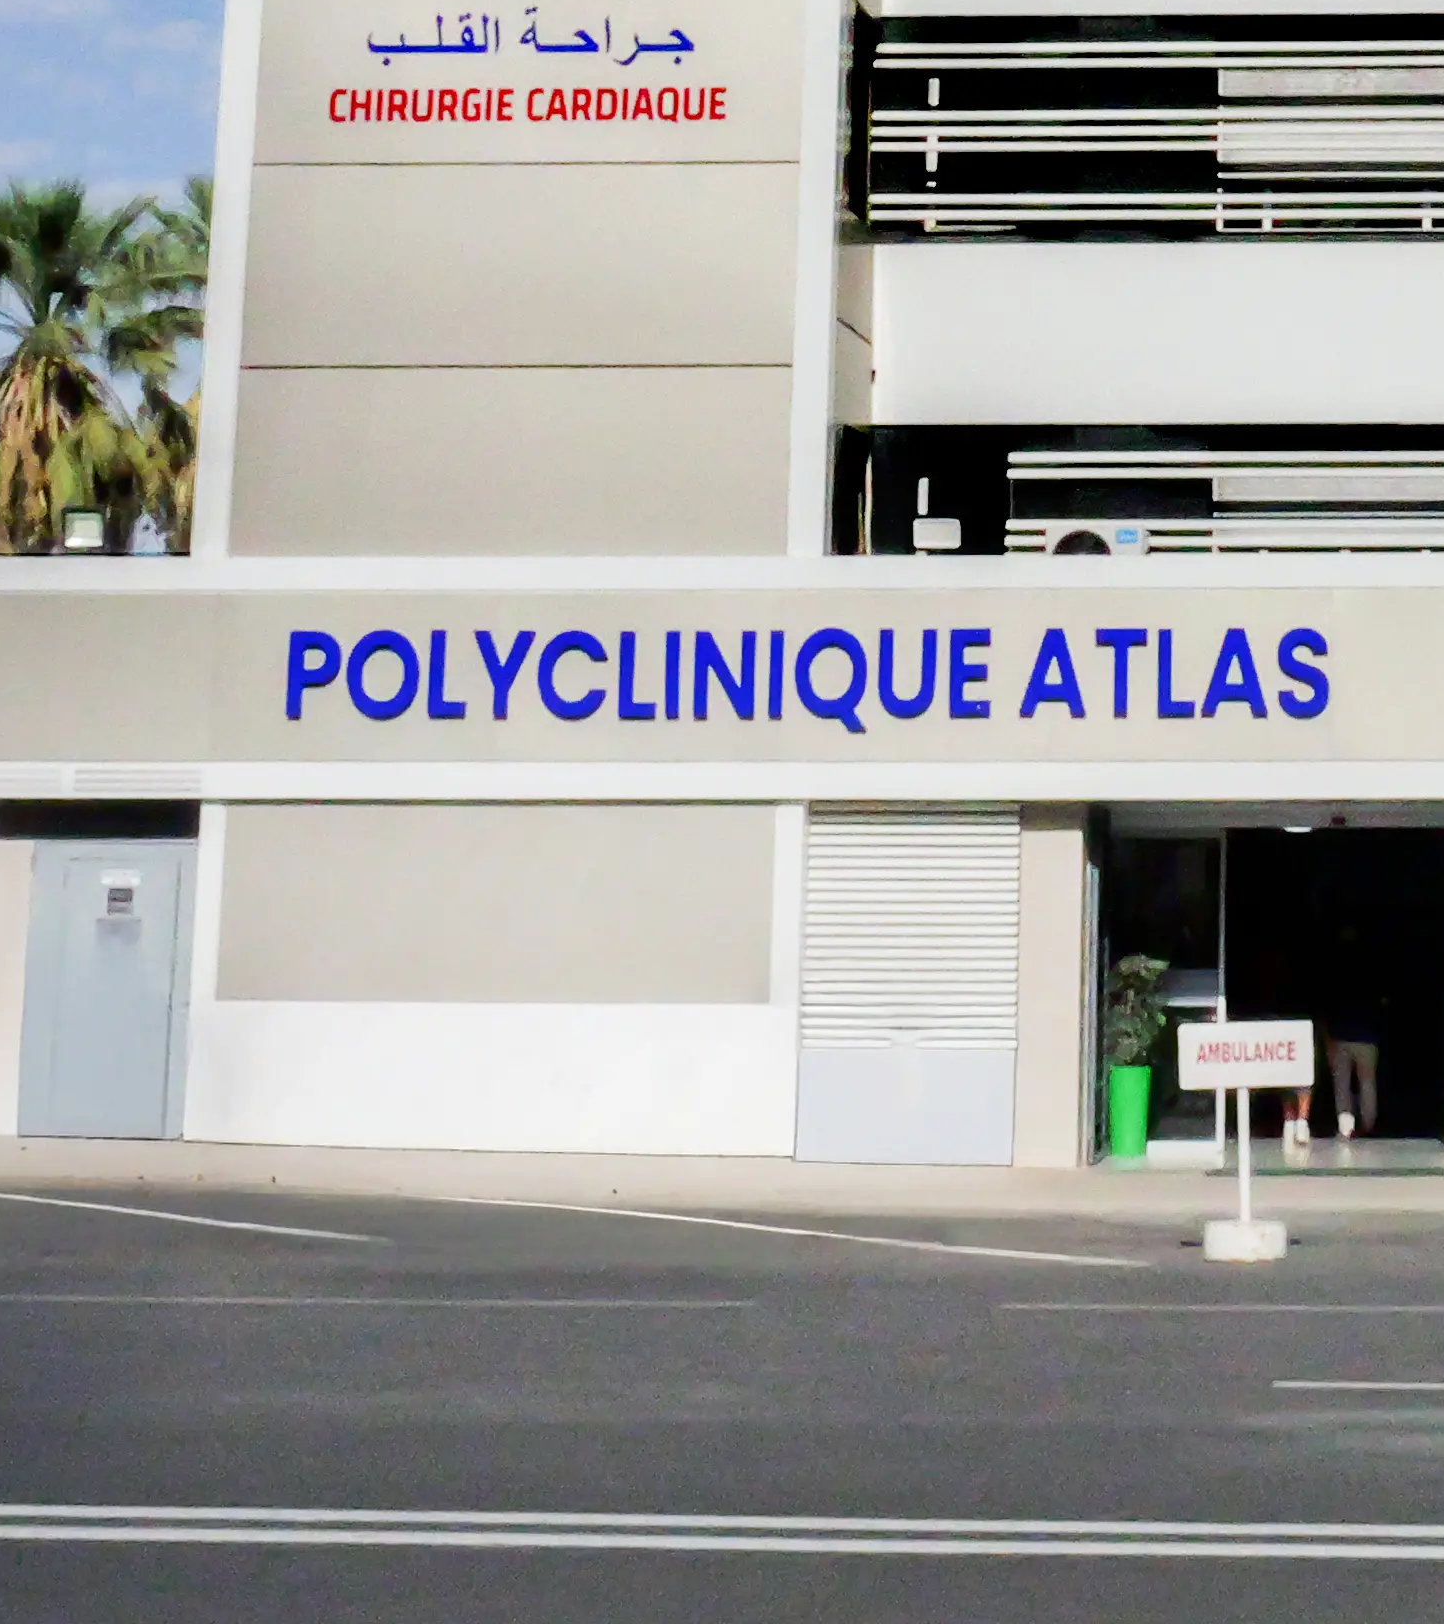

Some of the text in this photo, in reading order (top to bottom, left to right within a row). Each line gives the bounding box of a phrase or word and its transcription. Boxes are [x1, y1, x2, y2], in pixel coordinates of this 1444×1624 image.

[368, 7, 694, 66] جراحة القلب
[329, 87, 727, 123] CHIRURGIE CARDIAQUE
[286, 628, 1329, 734] POLYCLINIQUE ATLAS
[1197, 1041, 1296, 1063] AMBULANCE
